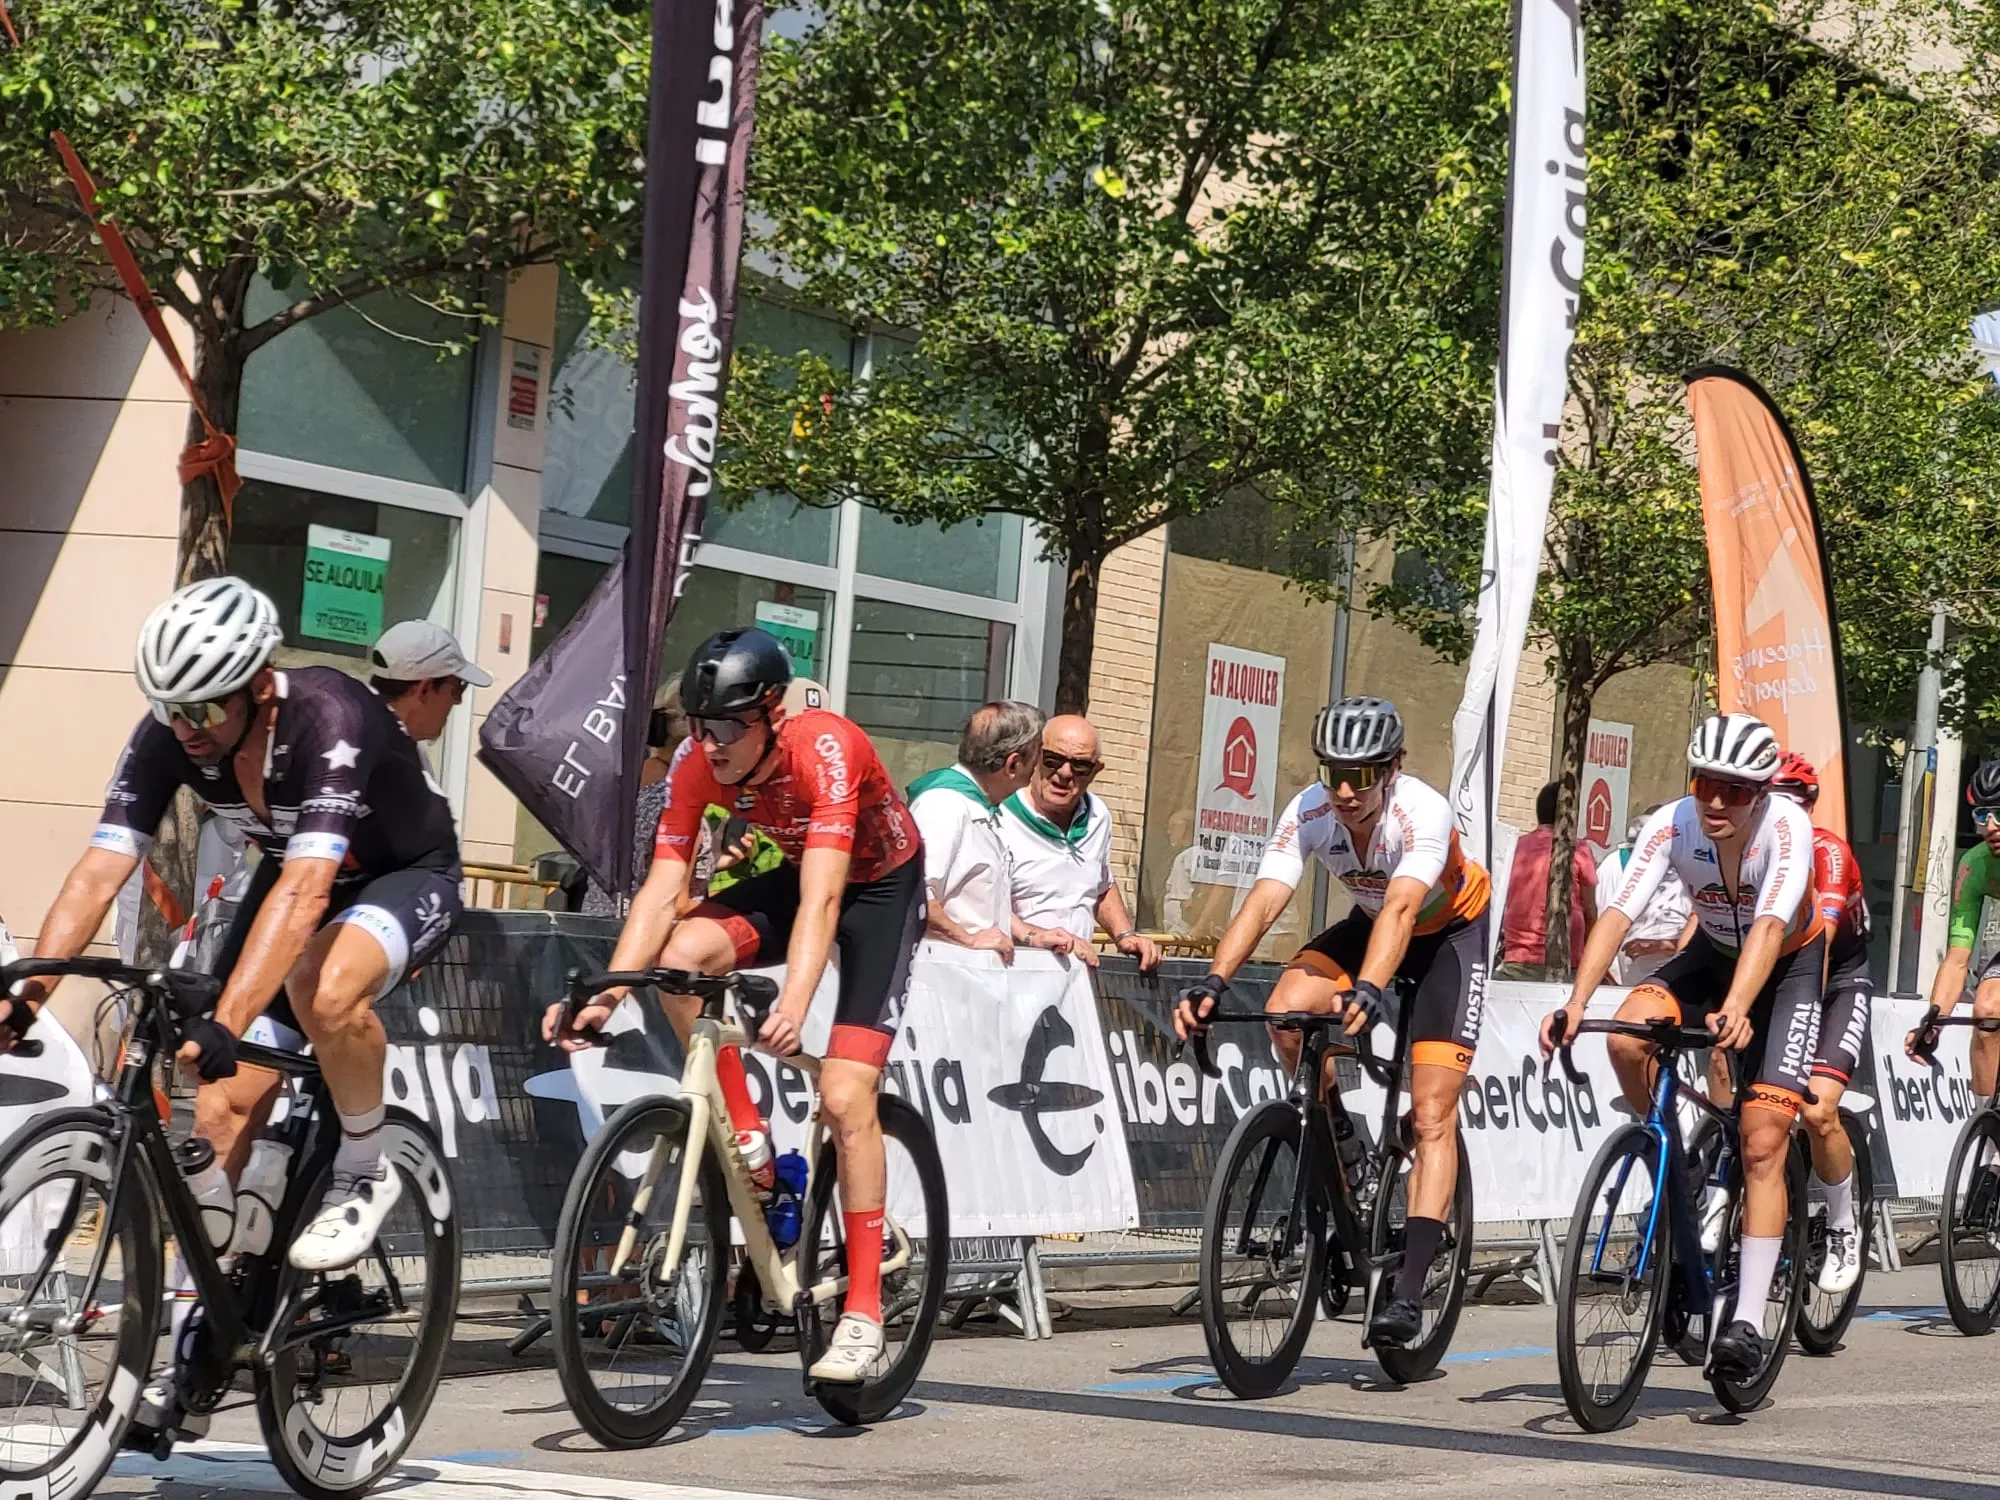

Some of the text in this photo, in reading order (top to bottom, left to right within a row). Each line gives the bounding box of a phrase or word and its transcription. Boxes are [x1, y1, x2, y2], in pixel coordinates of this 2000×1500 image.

[305, 560, 385, 594] SE ALQUILA
[1210, 659, 1279, 707] EN ALQUILER
[1588, 731, 1629, 768] ALQUILER
[1614, 867, 1646, 907] HOSTAL
[1461, 963, 1484, 1040] HOSTAL
[1778, 1002, 1812, 1077] HOSTAL
[1457, 1055, 1601, 1151] berCaja
